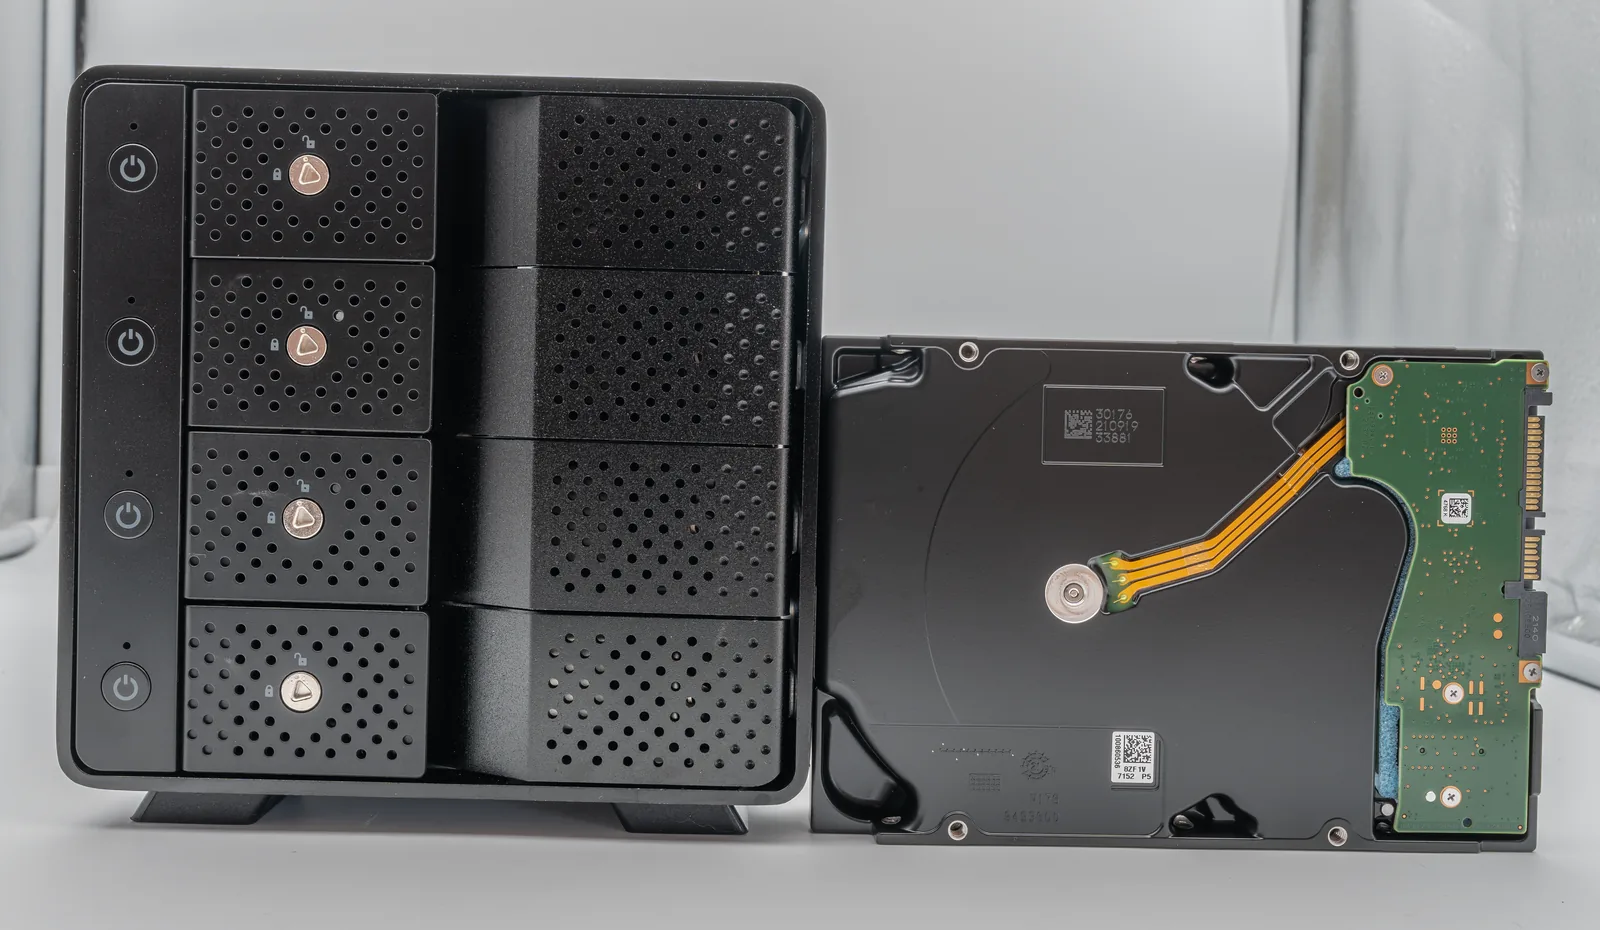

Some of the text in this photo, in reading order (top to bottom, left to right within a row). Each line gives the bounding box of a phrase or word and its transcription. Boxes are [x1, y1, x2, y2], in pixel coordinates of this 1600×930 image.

[1096, 408, 1132, 420] 30176
[1096, 420, 1138, 432] 210919
[1096, 432, 1131, 443] 33881
